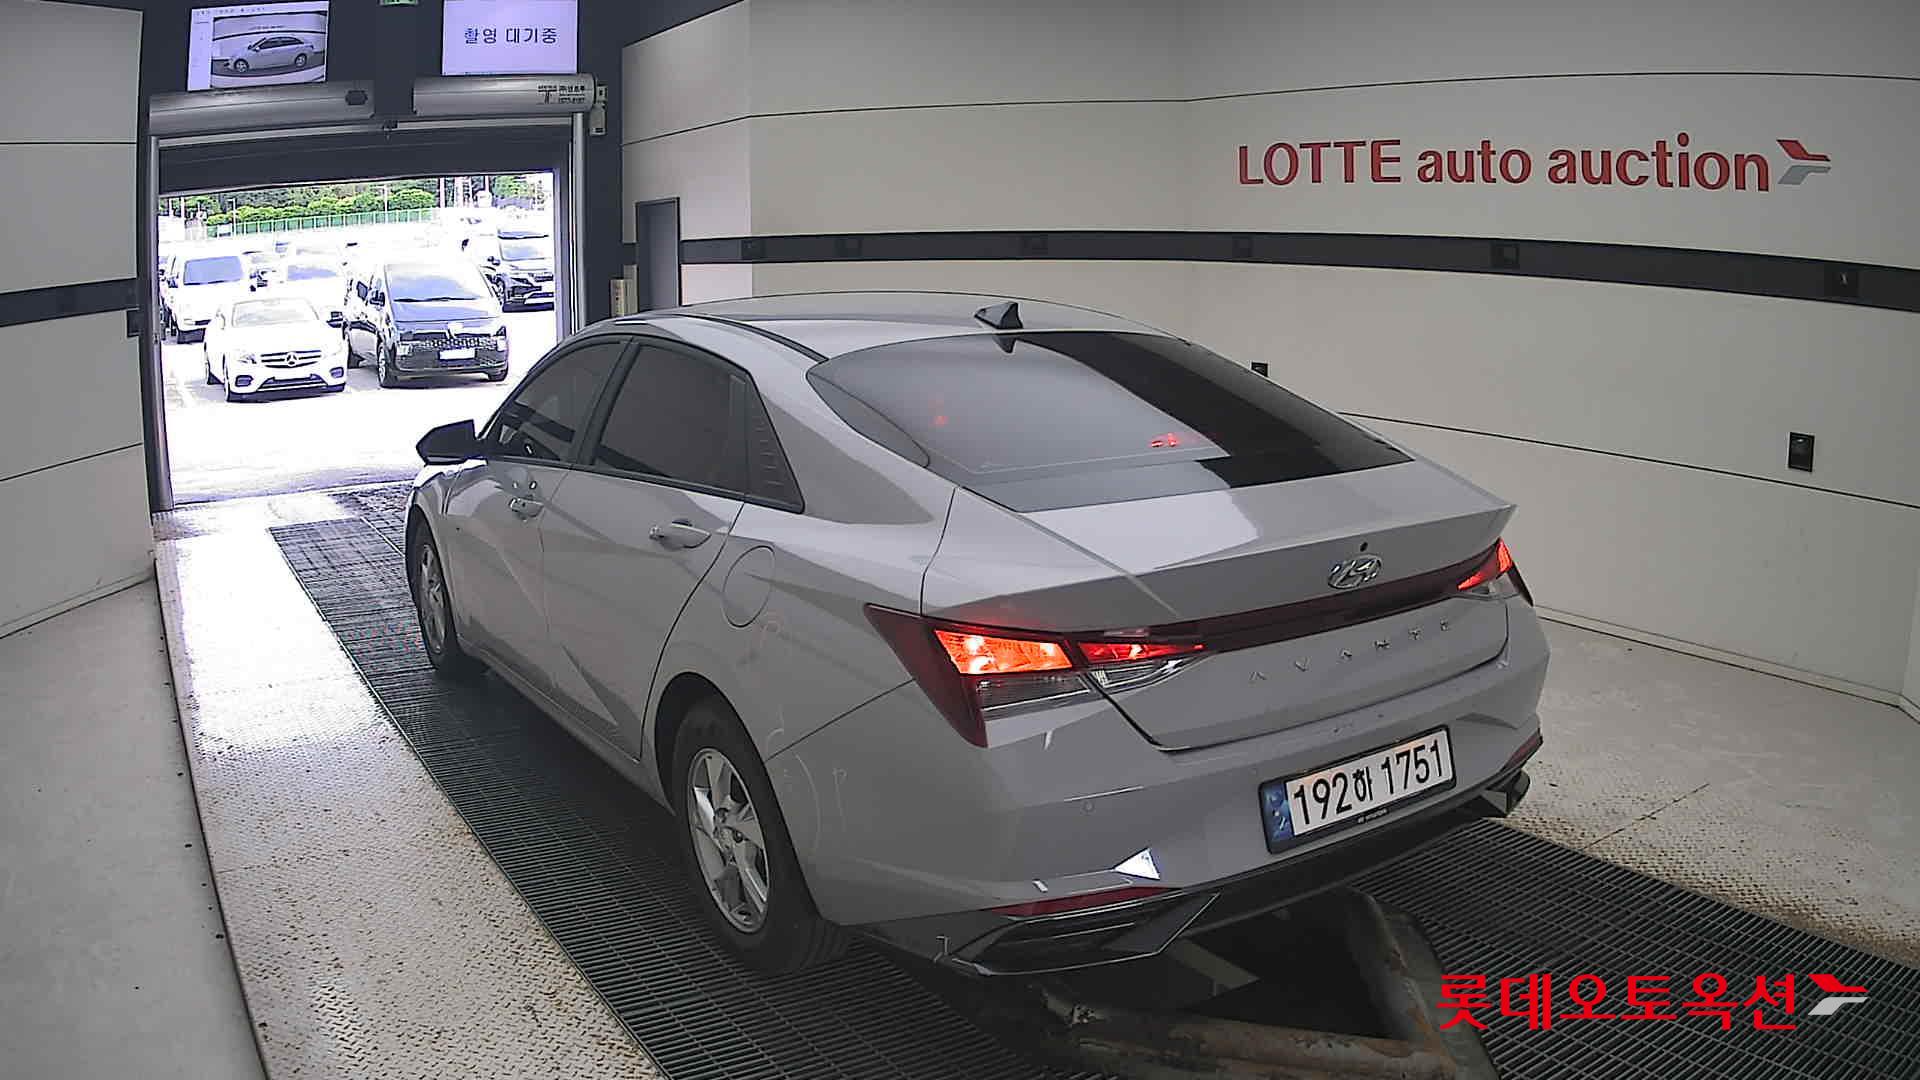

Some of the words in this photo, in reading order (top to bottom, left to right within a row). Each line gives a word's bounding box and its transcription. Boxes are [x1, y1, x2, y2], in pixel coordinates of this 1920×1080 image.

[464, 28, 497, 45] 촬영
[505, 28, 558, 45] 대기중
[1238, 140, 1401, 186] LOTTE
[1417, 140, 1533, 184] auto
[1548, 132, 1770, 191] auction
[1250, 616, 1450, 681] AVANTE
[1293, 766, 1374, 825] 192하
[1381, 739, 1443, 796] 1751
